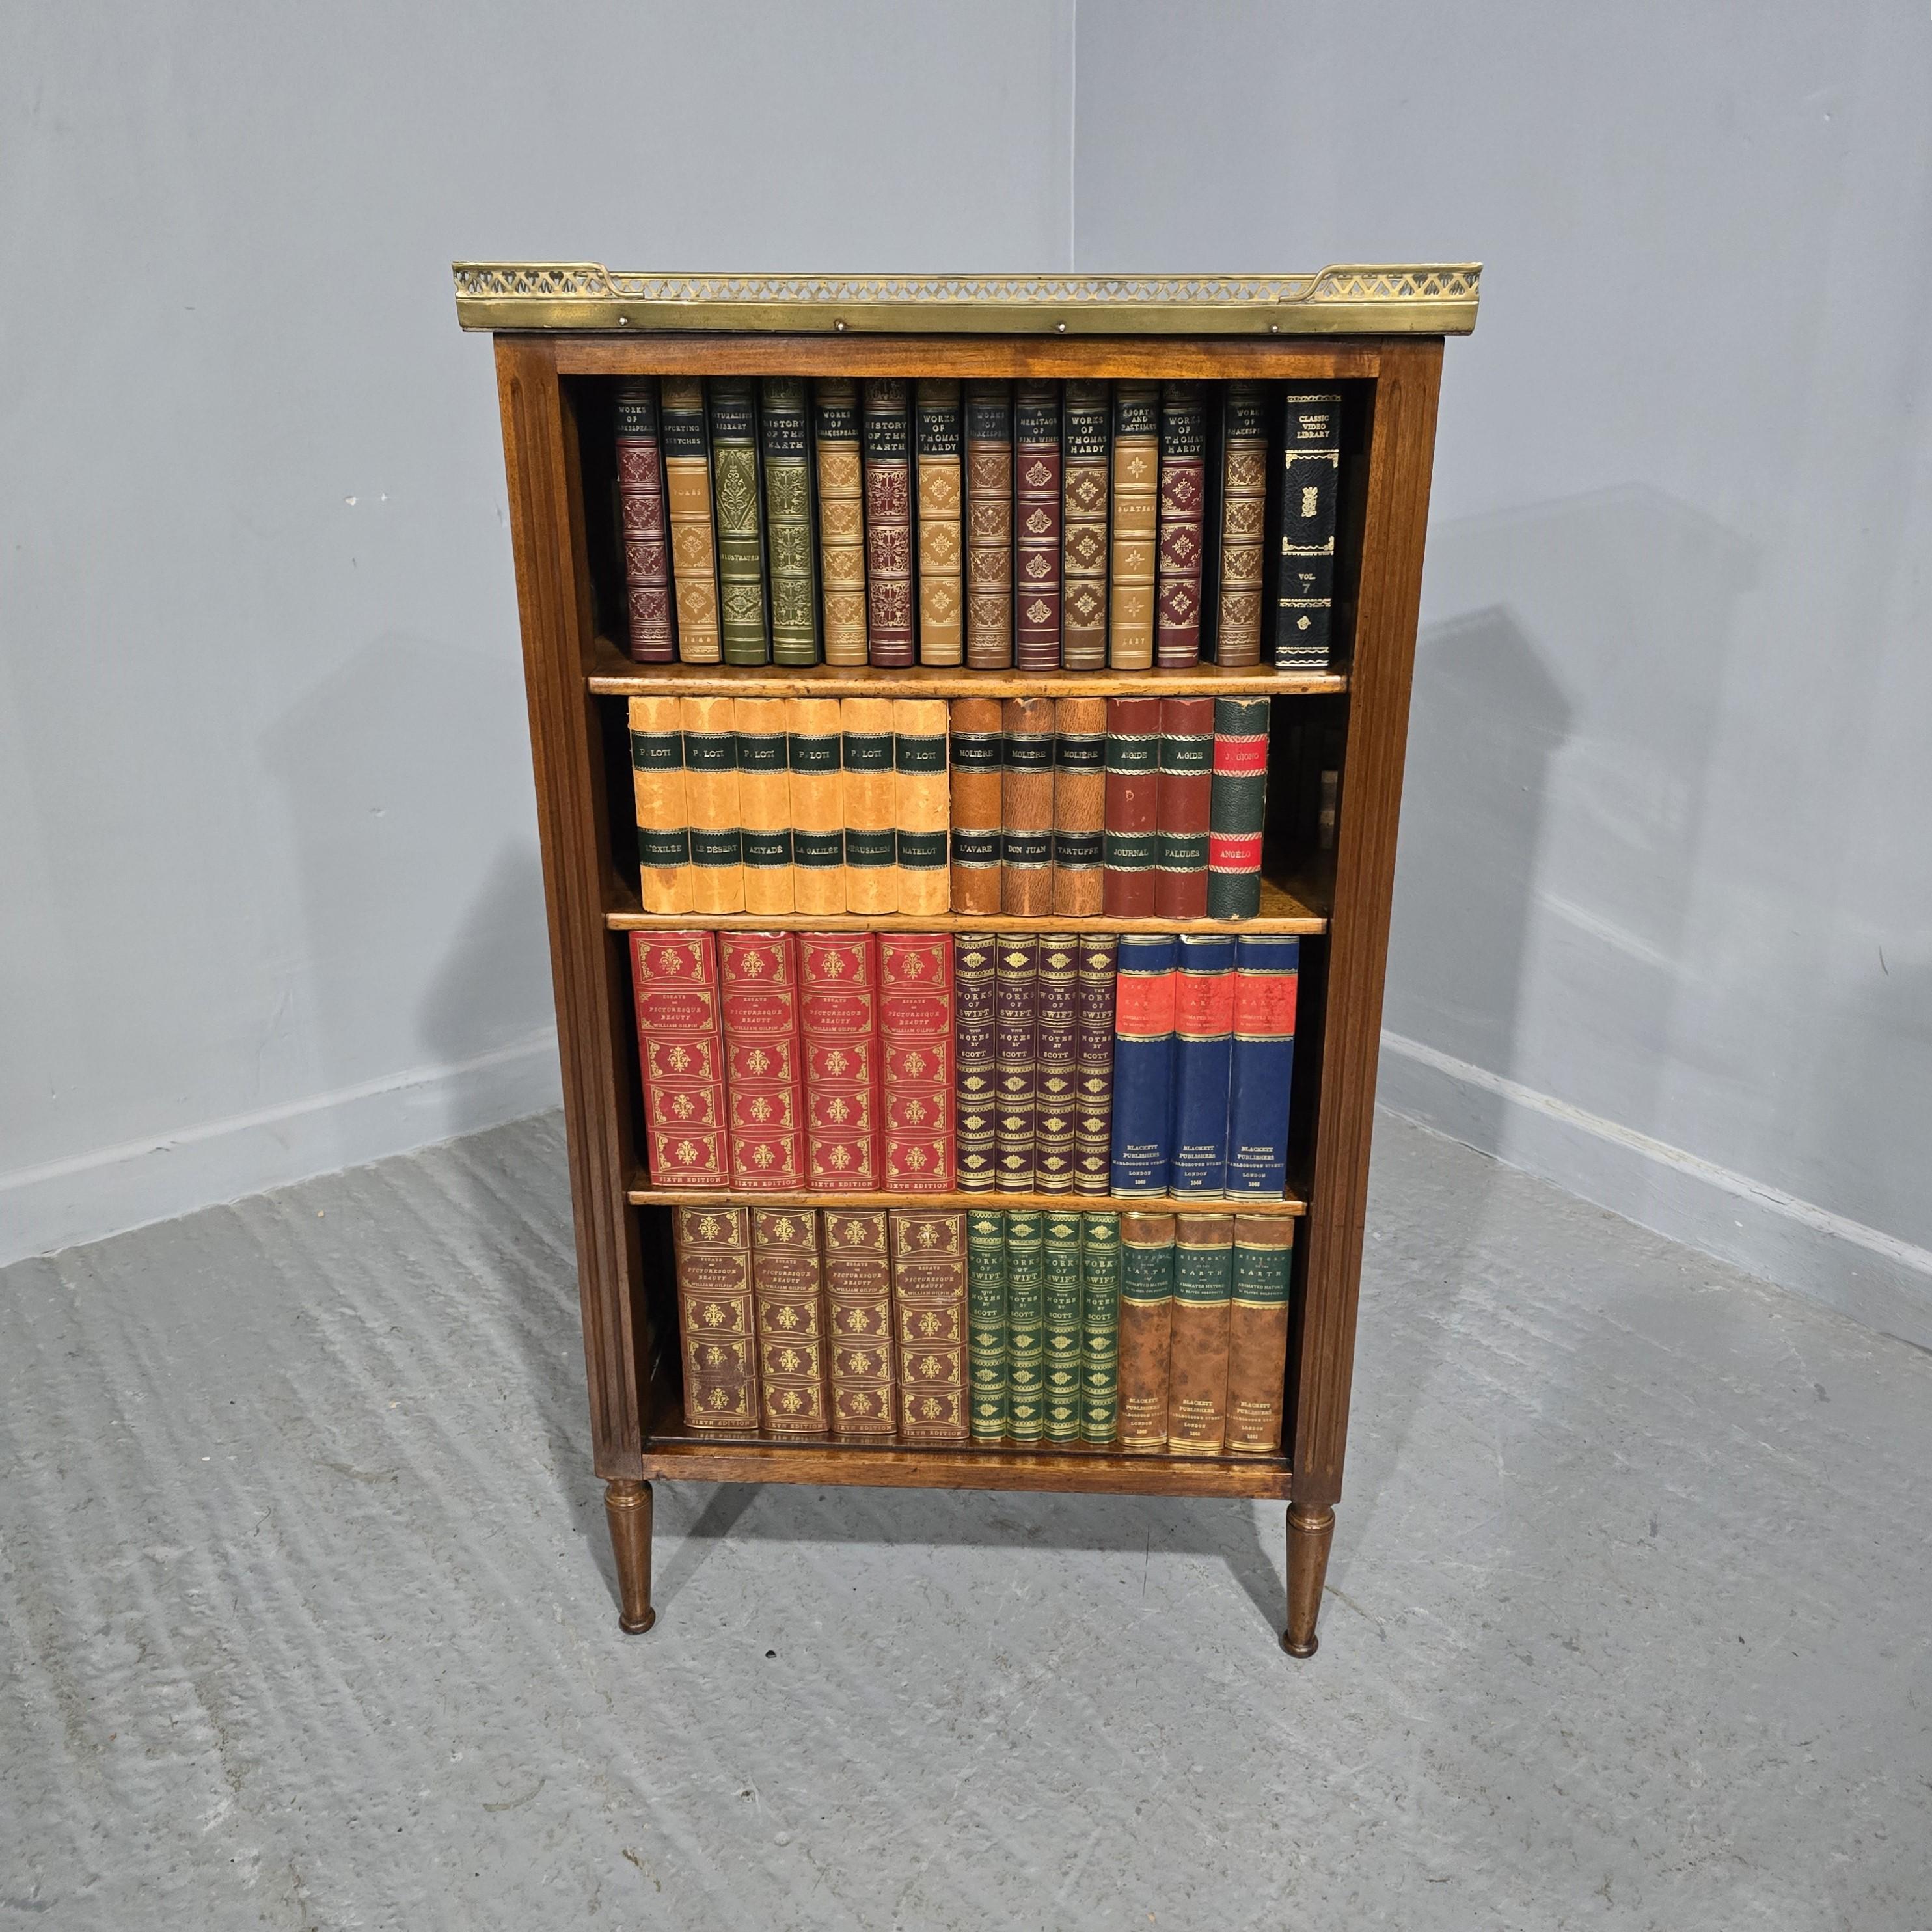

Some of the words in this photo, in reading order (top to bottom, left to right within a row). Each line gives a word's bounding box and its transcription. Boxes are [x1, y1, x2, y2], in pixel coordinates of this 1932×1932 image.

[1169, 416, 1201, 425] WORKS
[1071, 445, 1104, 454] HARDY
[1168, 445, 1201, 454] HARDY
[1303, 584, 1311, 593] 7
[704, 750, 724, 758] LOTI
[810, 751, 830, 759] LOTI
[862, 750, 882, 758] LOTI
[903, 847, 937, 856] MATELOT
[960, 845, 993, 854] L'AVARE
[1008, 845, 1022, 854] DON
[1026, 845, 1046, 854] JUAN
[1057, 847, 1099, 855] TARTUFFE
[1113, 849, 1149, 857] JOURNAL
[959, 1009, 990, 1018] SWIFT
[1000, 1009, 1032, 1018] SWIFT
[1042, 1011, 1073, 1019] SWIFT
[1082, 1011, 1113, 1020] SWIFT
